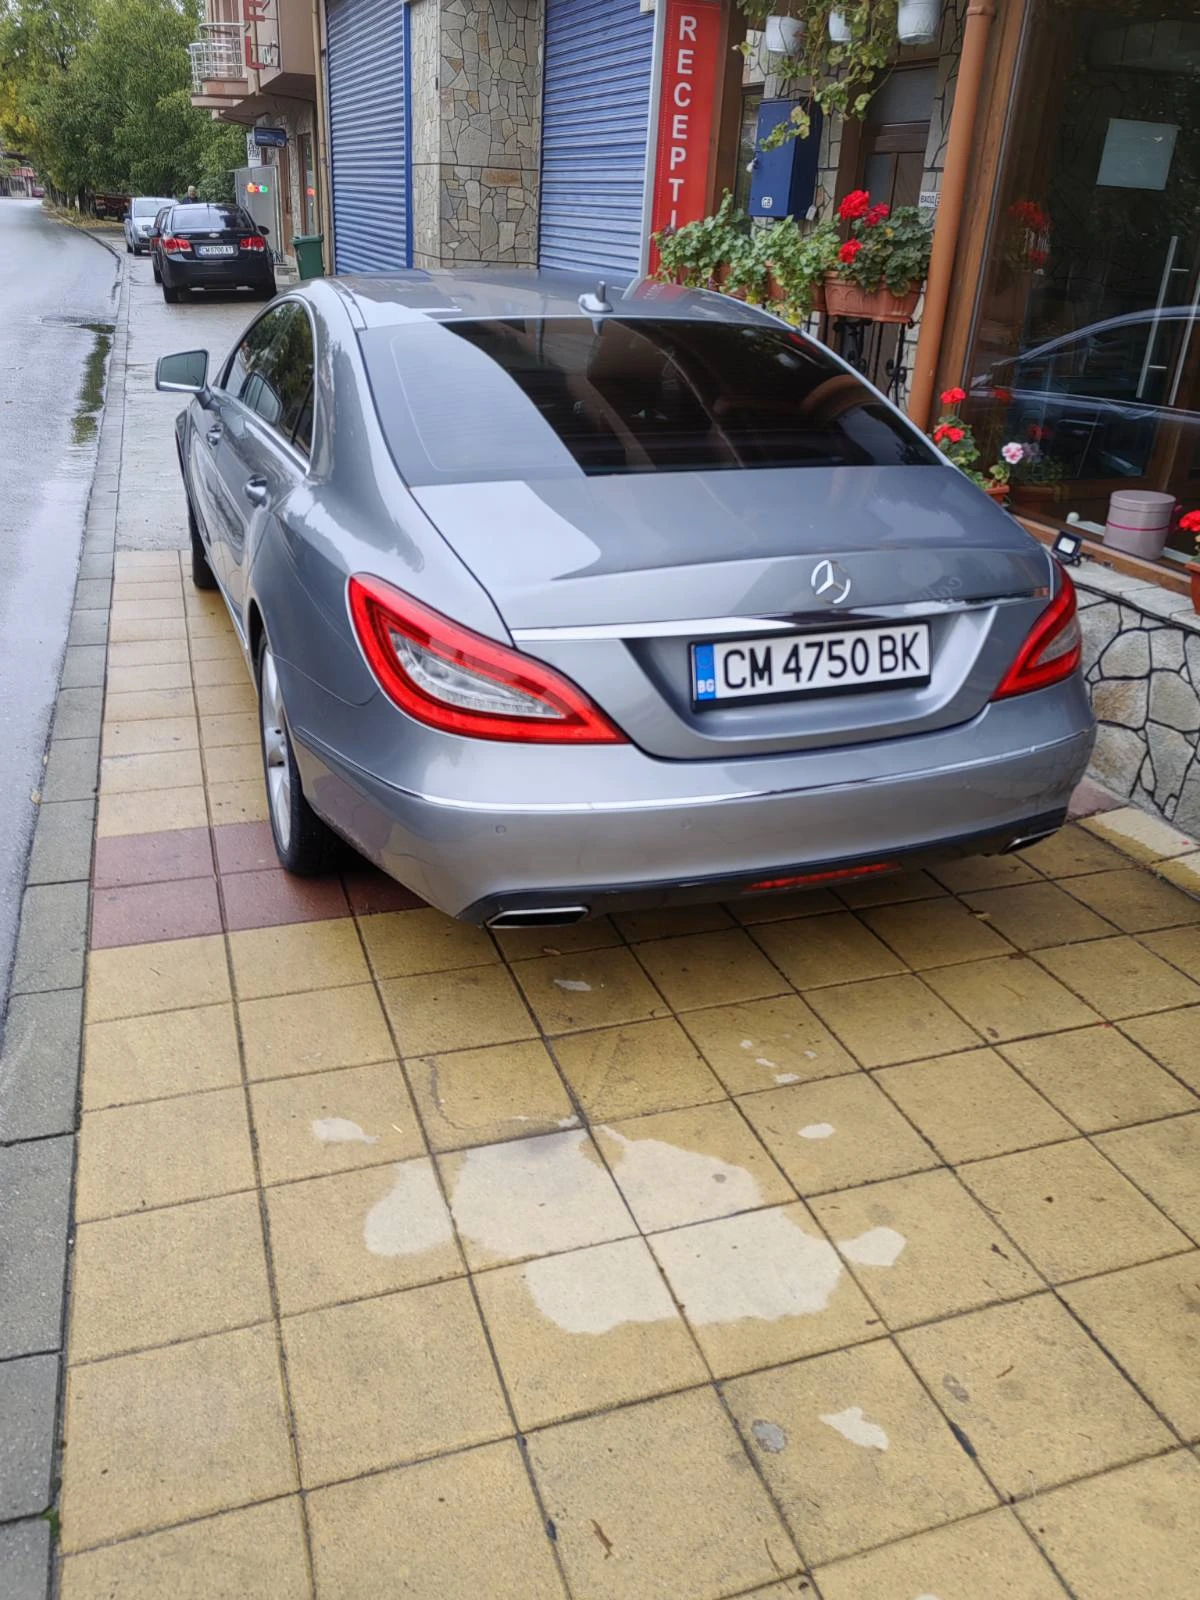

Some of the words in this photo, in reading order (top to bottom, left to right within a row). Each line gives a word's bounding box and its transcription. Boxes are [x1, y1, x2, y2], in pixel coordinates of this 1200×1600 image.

[697, 679, 714, 692] BG
[723, 645, 773, 689] CM
[782, 637, 870, 683] 4750
[879, 631, 921, 674] BK
